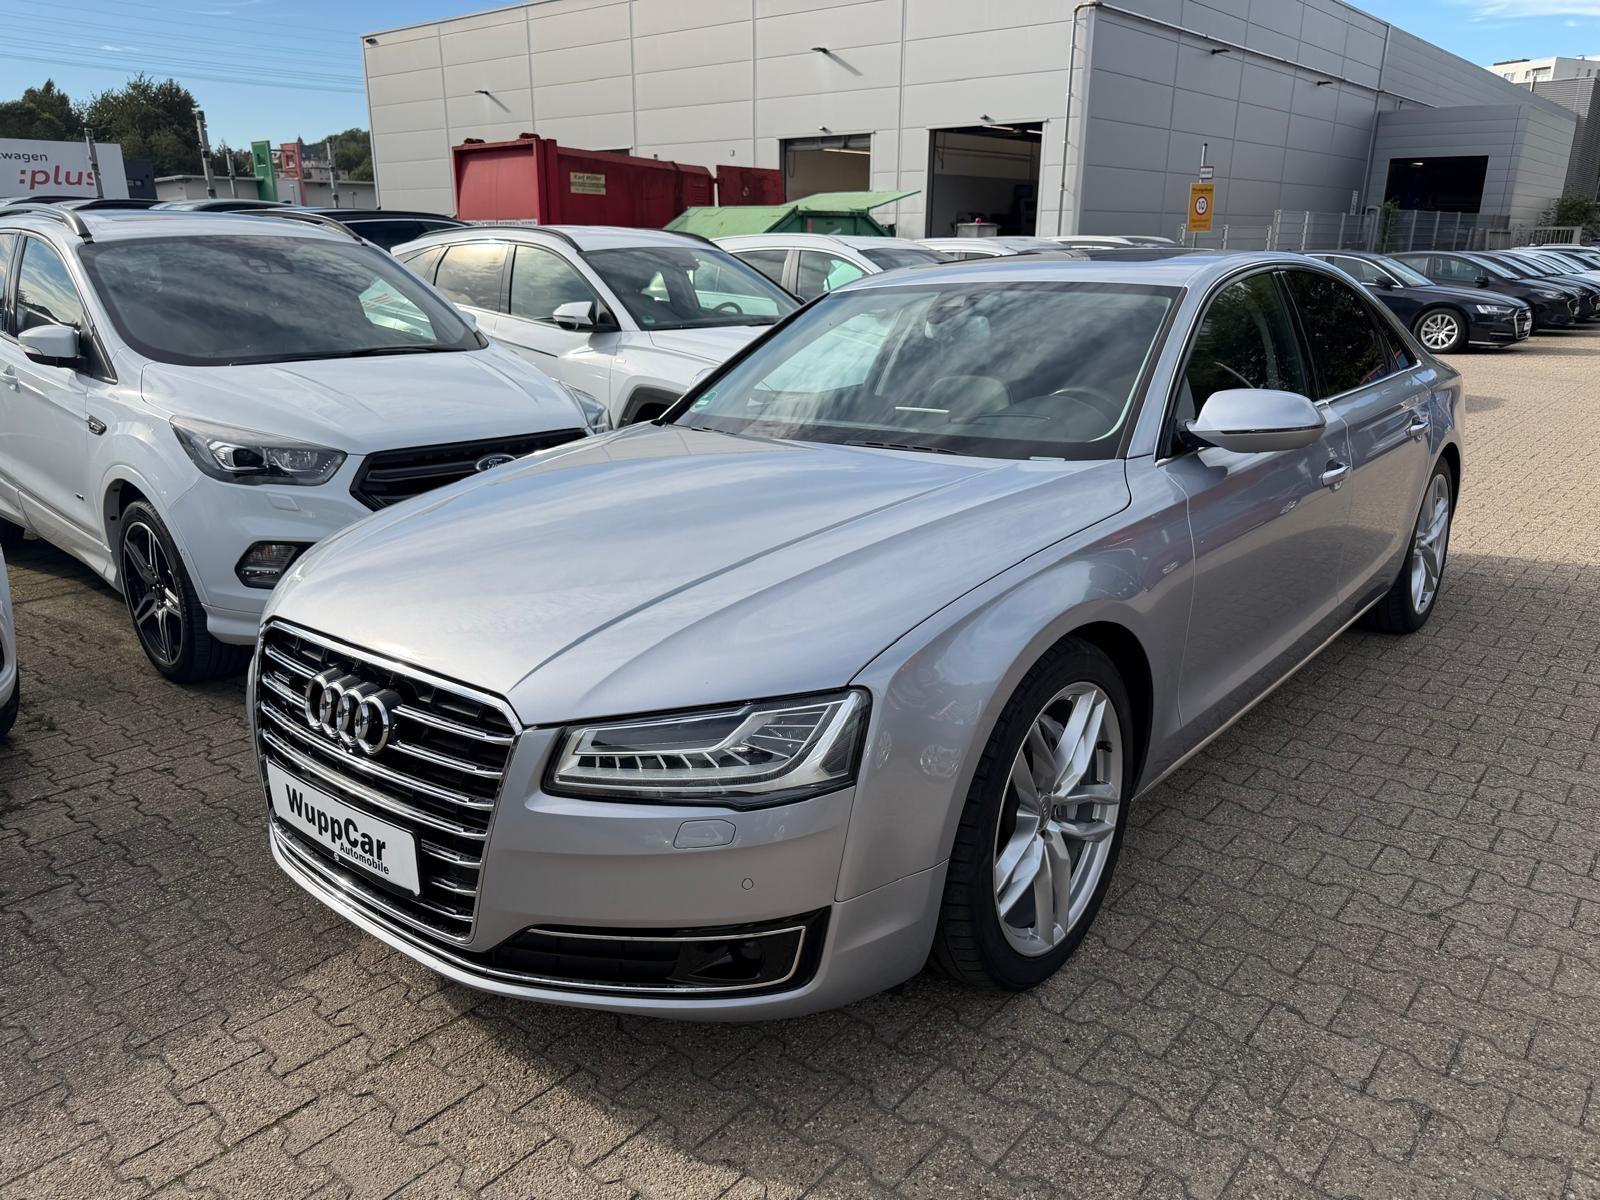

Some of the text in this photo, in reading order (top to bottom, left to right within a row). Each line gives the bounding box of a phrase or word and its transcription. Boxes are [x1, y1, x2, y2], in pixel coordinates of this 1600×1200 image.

[0, 152, 48, 163] wagen
[1198, 200, 1205, 211] 10
[285, 784, 386, 861] WuppCar
[340, 842, 390, 875] Automobile
